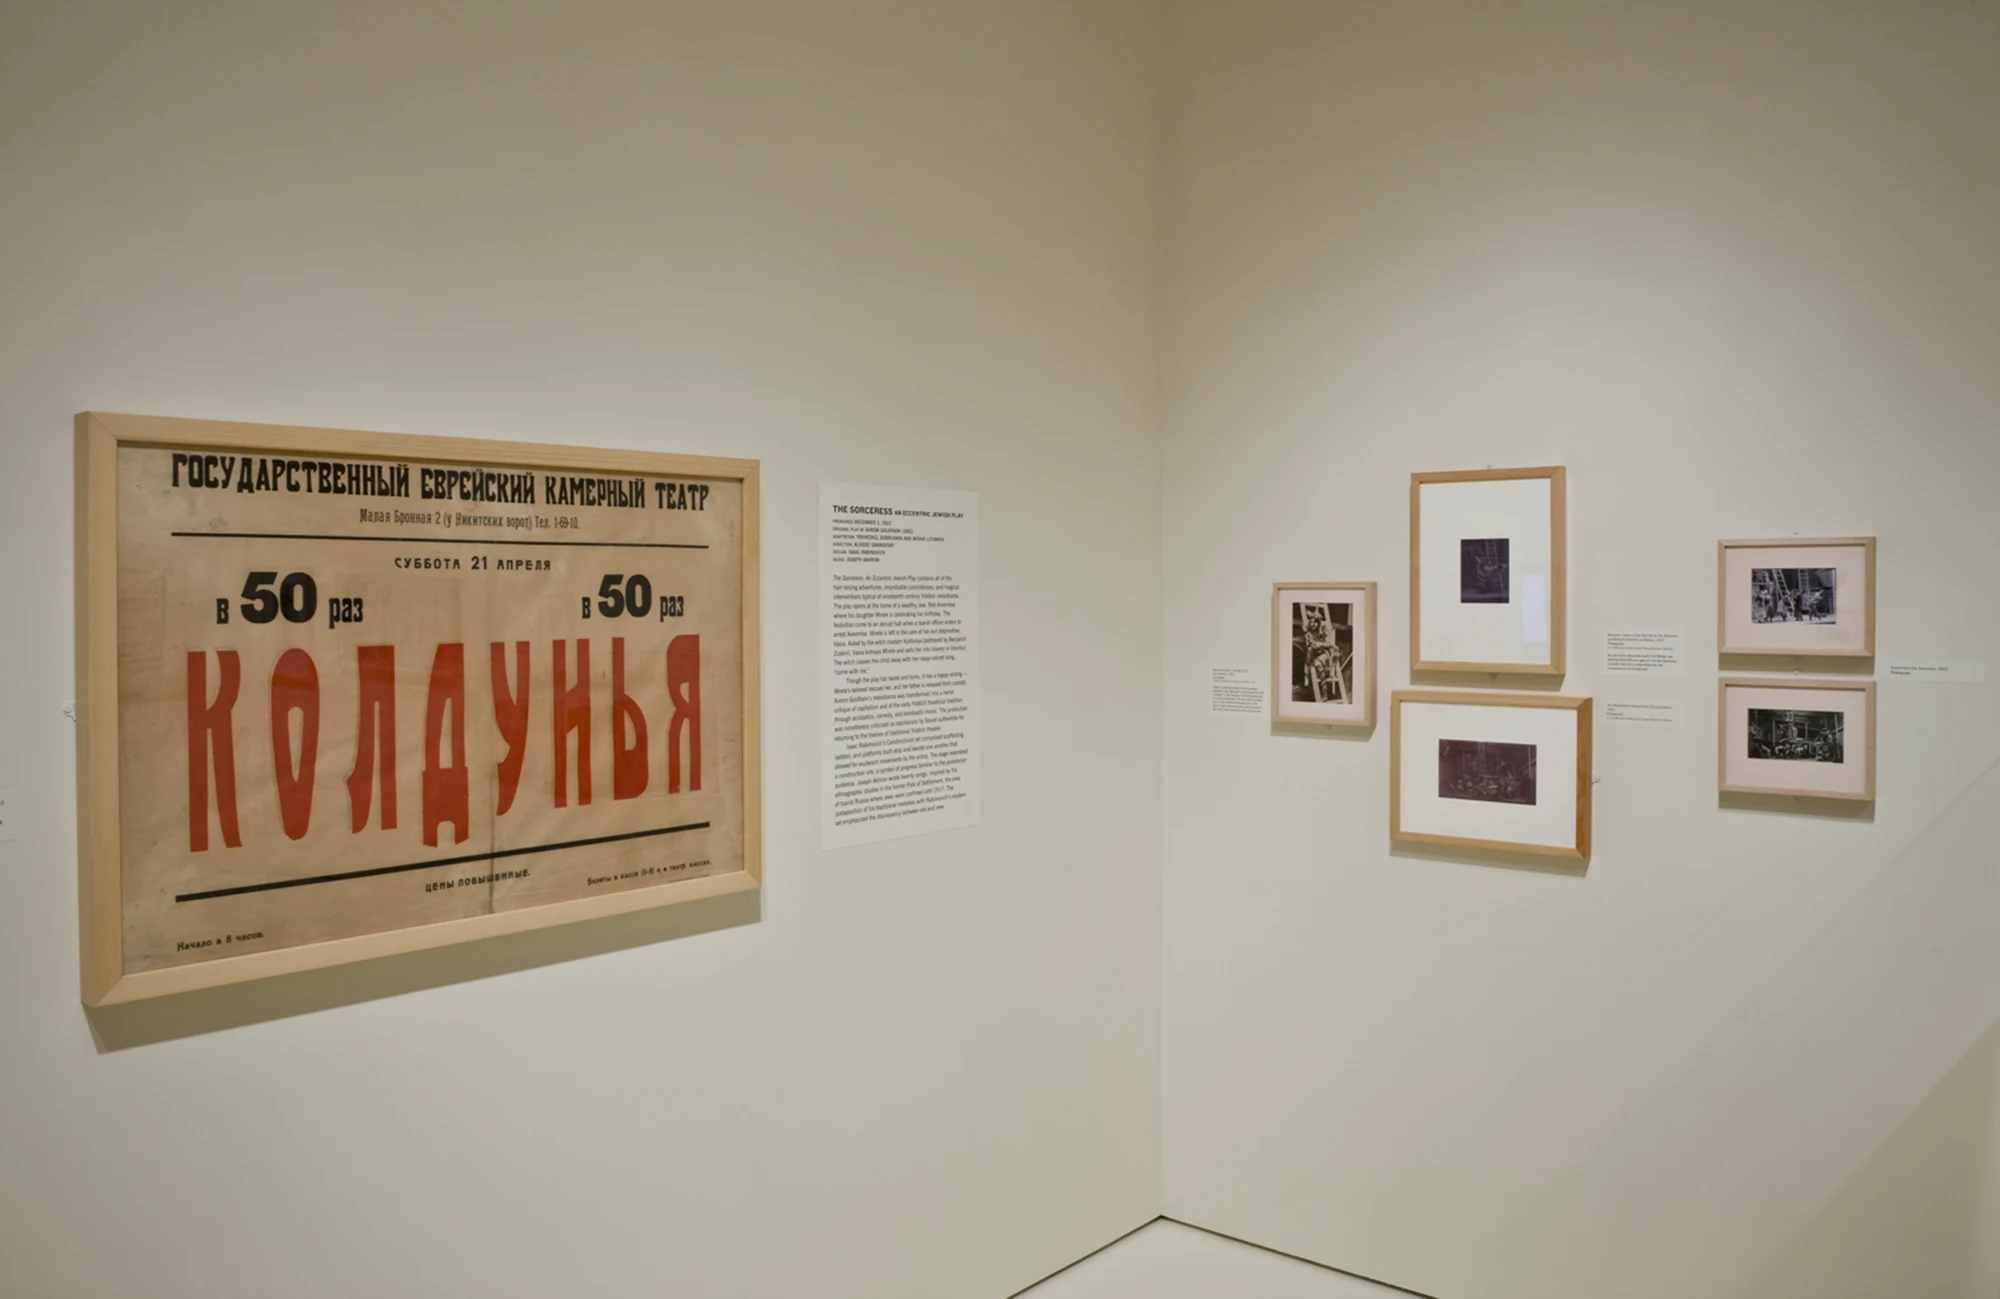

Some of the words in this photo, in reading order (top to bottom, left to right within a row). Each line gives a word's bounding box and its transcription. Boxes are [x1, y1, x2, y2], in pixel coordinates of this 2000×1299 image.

[172, 453, 409, 497] ГОСУДАРСТВЕННЫЙ
[421, 467, 535, 504] ЕВРЕЙСКИЙ
[545, 475, 645, 509] КАМЕРНЫЙ
[655, 481, 709, 511] ТЕАТР
[359, 508, 391, 524] Малая
[394, 510, 432, 526] Бронная
[435, 512, 441, 524] 2
[455, 512, 503, 528] Никитских
[506, 515, 533, 531] ворот)
[535, 515, 551, 529] Тел.
[834, 505, 848, 513] THE
[850, 506, 892, 515] SORCERESS
[394, 556, 460, 570] СУББОТА
[471, 555, 487, 570] 21
[497, 559, 551, 571] АПРЕЛЯ
[240, 571, 317, 624] 50
[328, 594, 364, 629] раз
[597, 573, 652, 618] 50
[660, 593, 685, 621] раз
[187, 633, 702, 853] КОЛДУНЬЯ
[176, 938, 213, 953] Начало
[225, 934, 232, 944] 8
